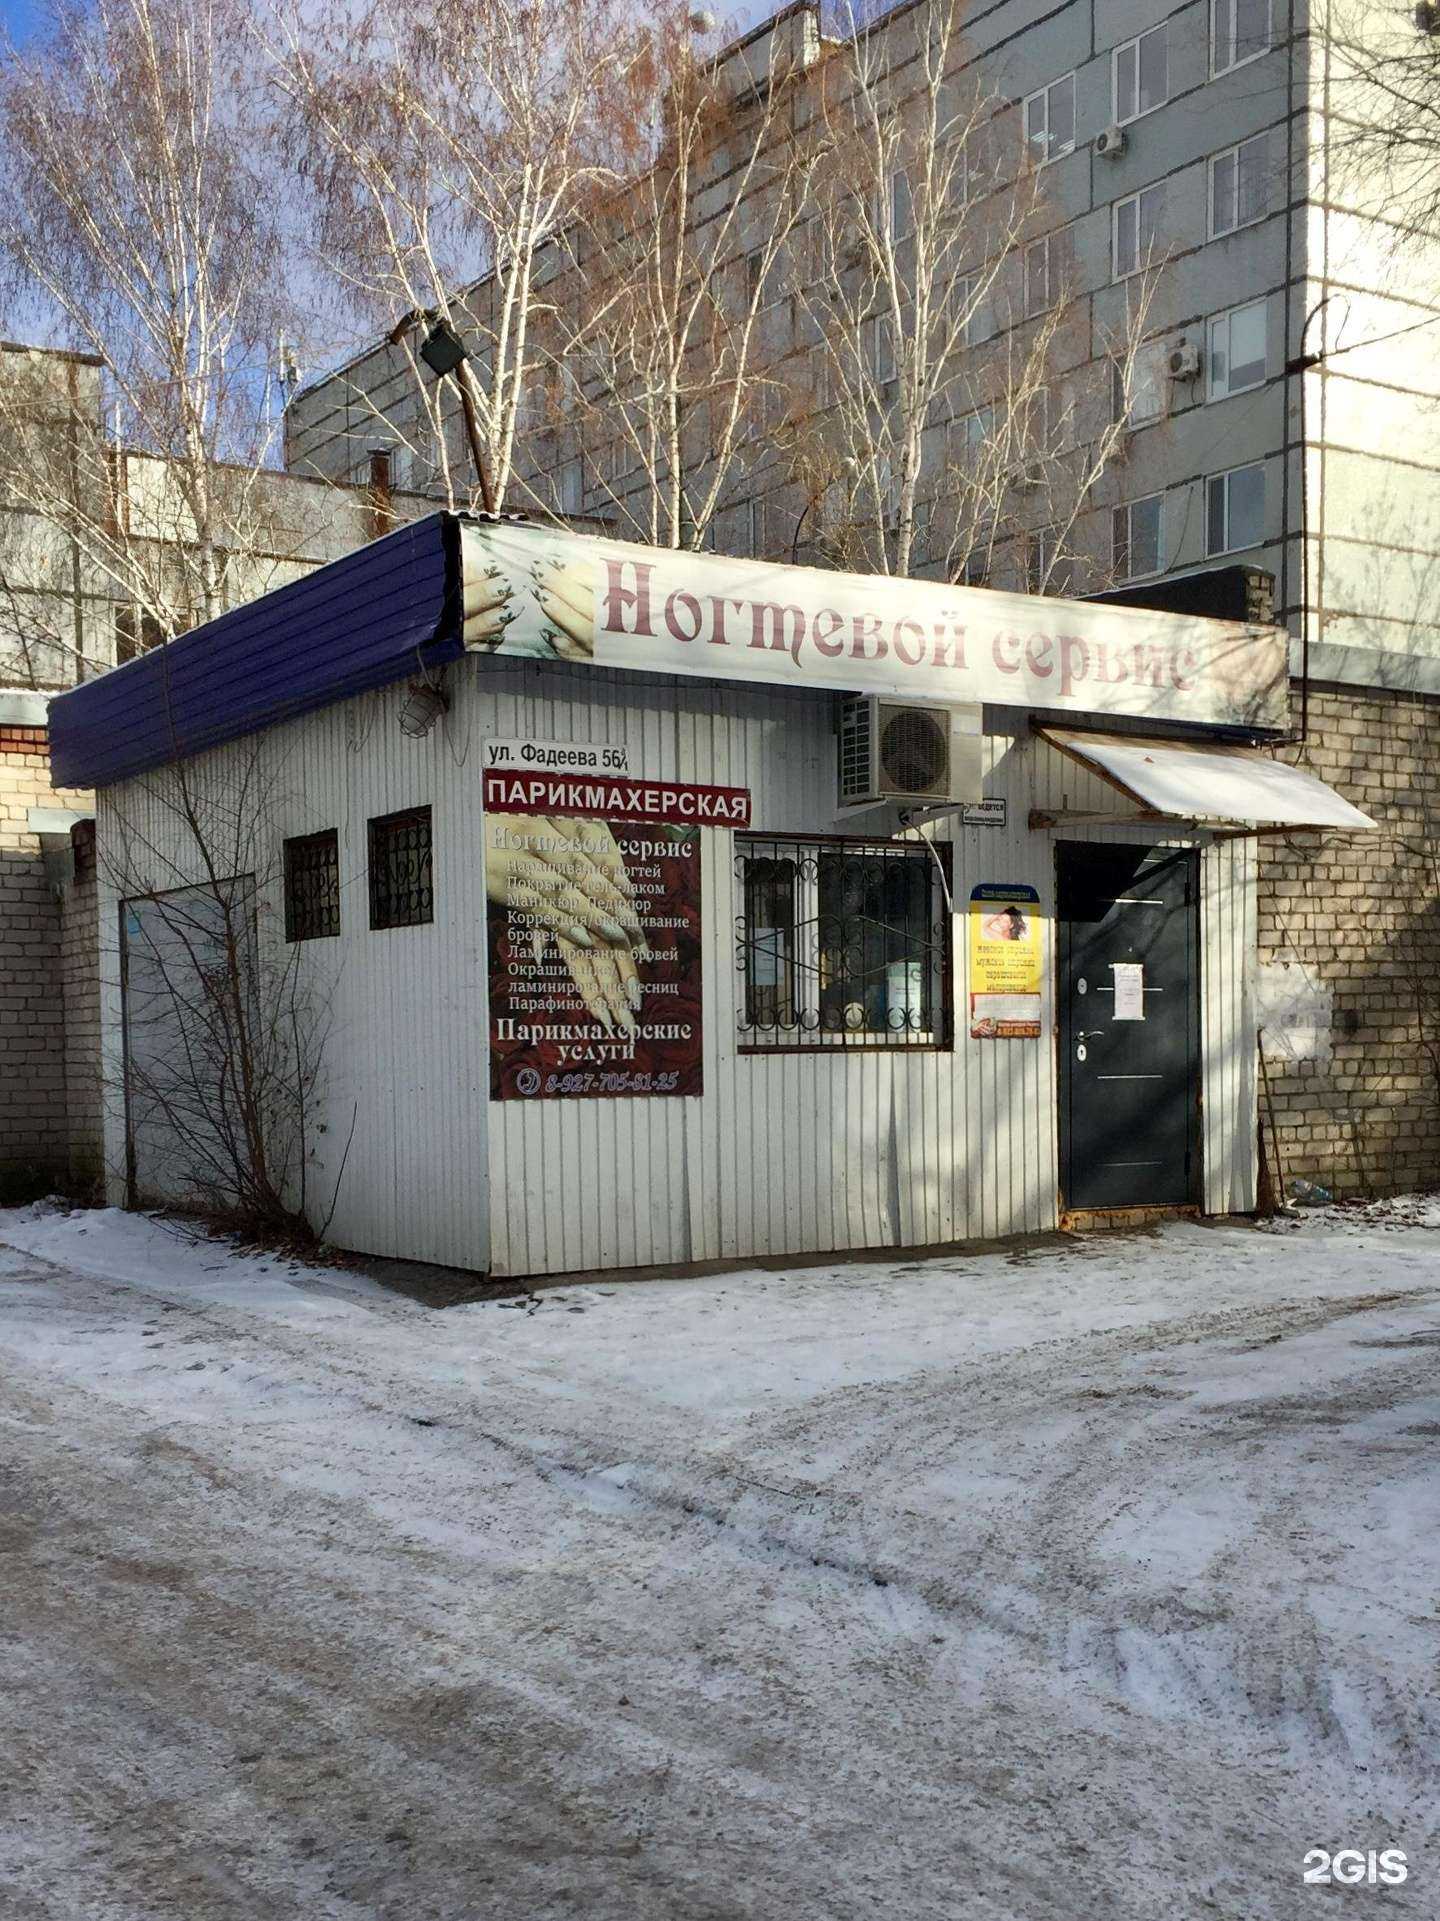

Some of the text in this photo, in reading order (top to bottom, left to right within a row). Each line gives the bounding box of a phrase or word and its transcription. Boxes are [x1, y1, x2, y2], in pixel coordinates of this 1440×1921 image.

[599, 558, 1198, 698] Ногтевой сервис
[488, 745, 515, 765] ул.
[520, 743, 598, 767] Фадеева
[487, 778, 748, 820] ПАРИКМАХЕРСКАЯ
[494, 826, 693, 861] Ногтевой сервис
[613, 862, 662, 880] ногтей
[506, 875, 581, 892] Покрытие
[507, 928, 560, 944] бровей
[507, 945, 679, 963] Ламинирование бровей
[508, 981, 680, 998] ламинирование ресниц
[496, 1018, 692, 1046] Парикмахерские
[556, 1043, 636, 1066] услуги
